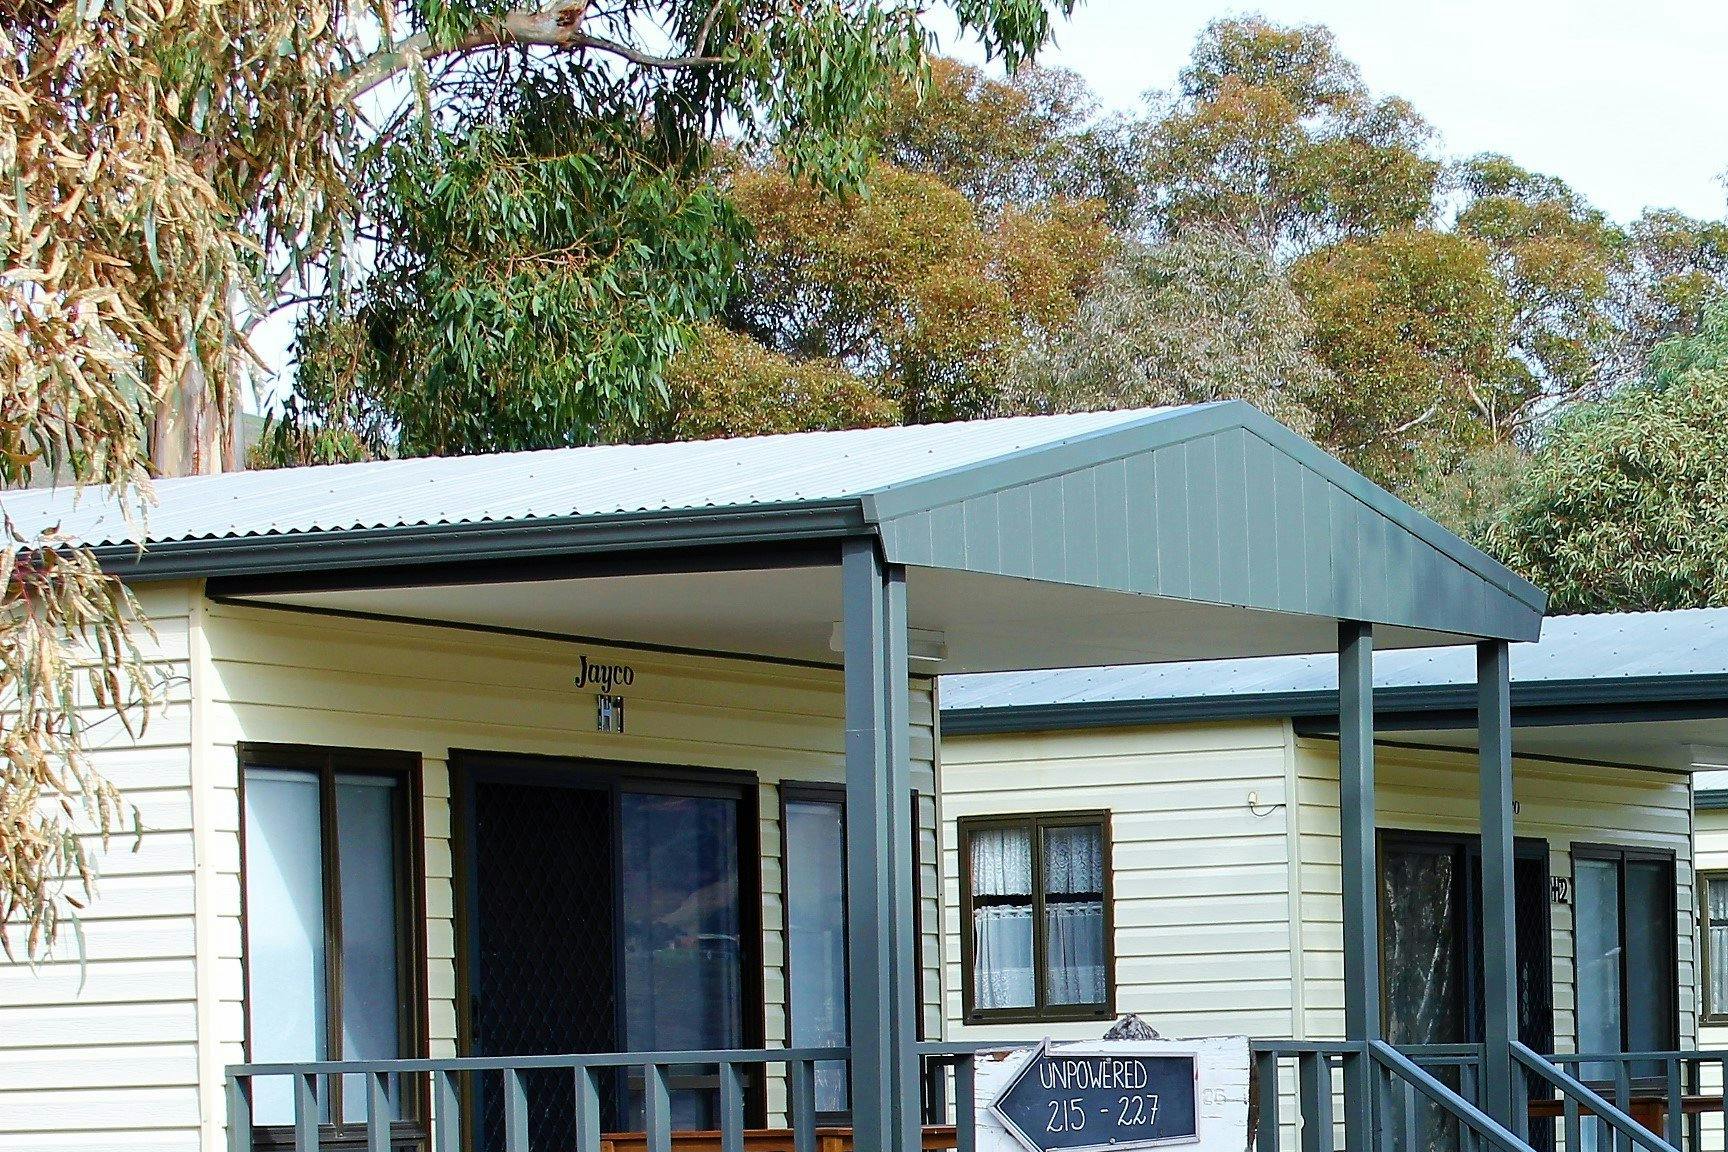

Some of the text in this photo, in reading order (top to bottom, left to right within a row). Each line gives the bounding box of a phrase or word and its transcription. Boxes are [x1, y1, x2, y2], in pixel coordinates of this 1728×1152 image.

[574, 655, 635, 694] Jayco
[1039, 1059, 1148, 1090] UNPOWERED
[1046, 1097, 1086, 1132] 215
[1117, 1094, 1160, 1126] 227
